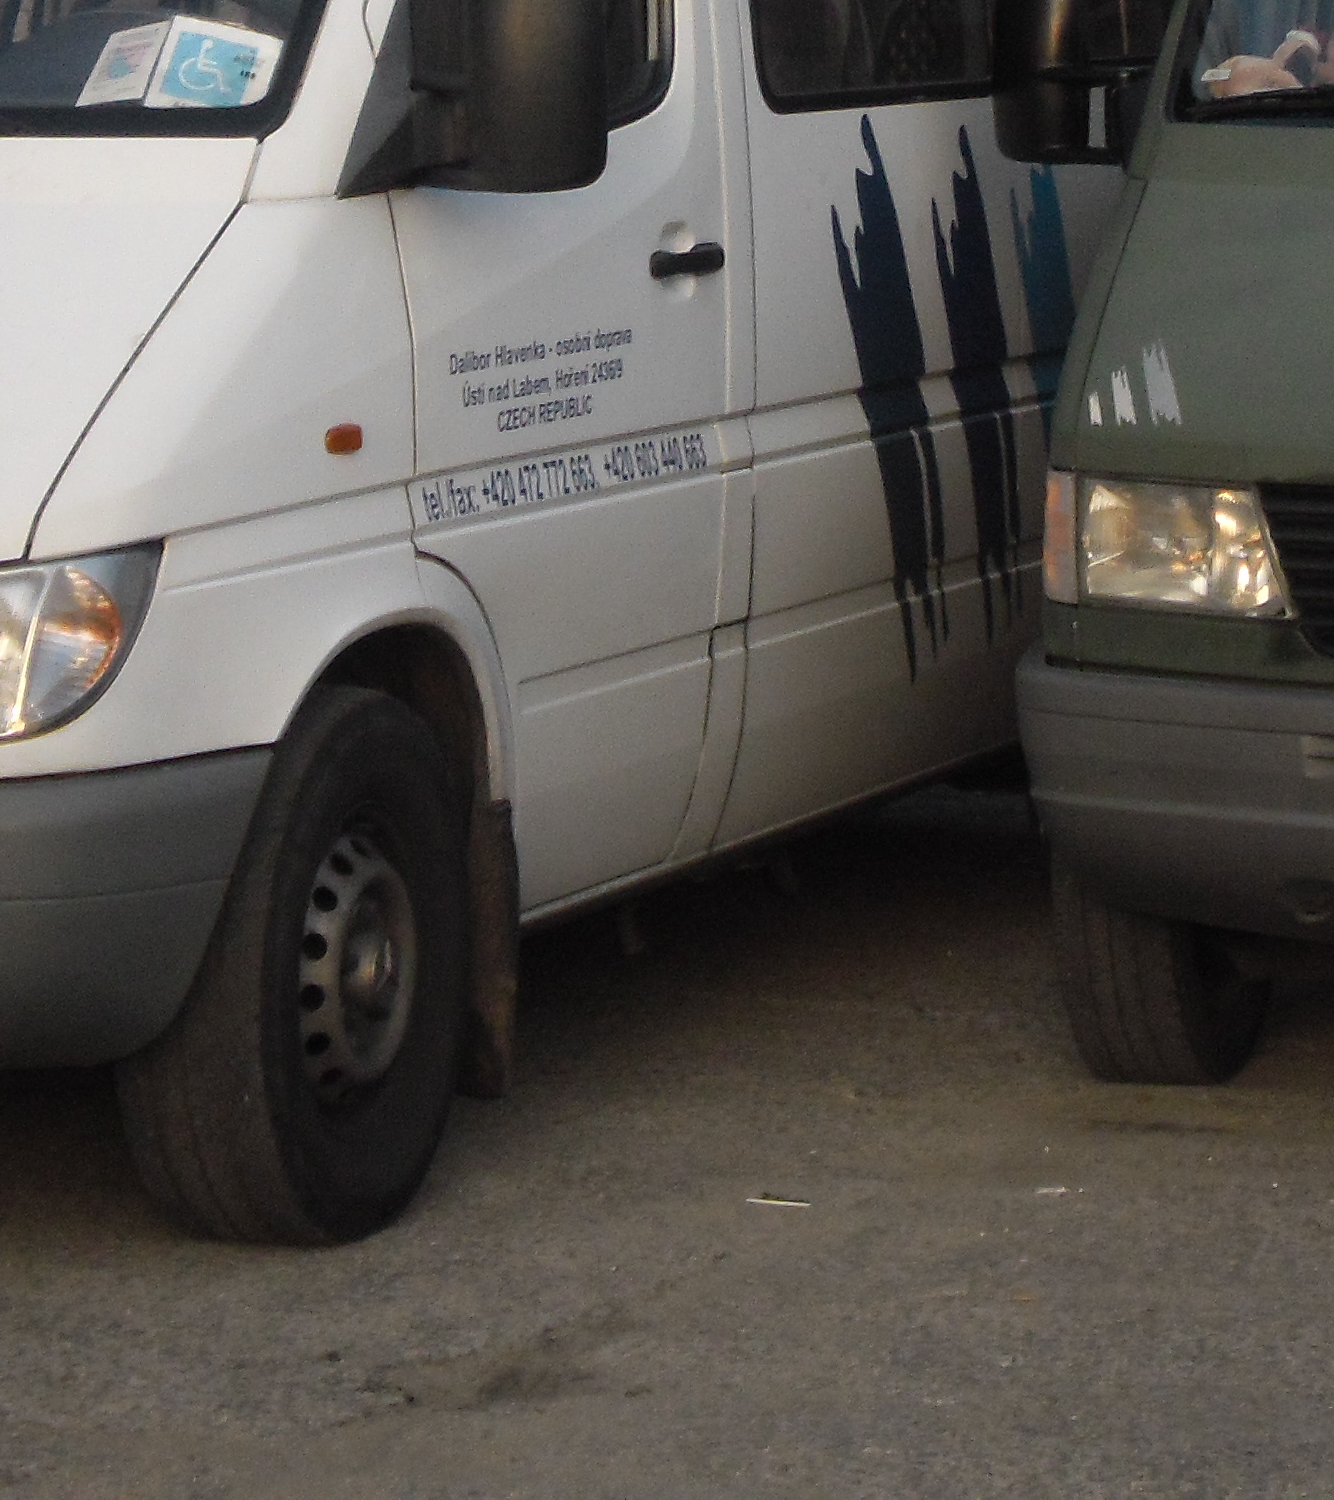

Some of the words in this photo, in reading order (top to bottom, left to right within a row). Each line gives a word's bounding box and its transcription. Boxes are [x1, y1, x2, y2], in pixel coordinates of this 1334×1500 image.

[449, 350, 492, 375] Dalibor
[488, 378, 510, 402] nad
[497, 405, 536, 432] CZECH
[538, 394, 593, 424] REPUBLIC
